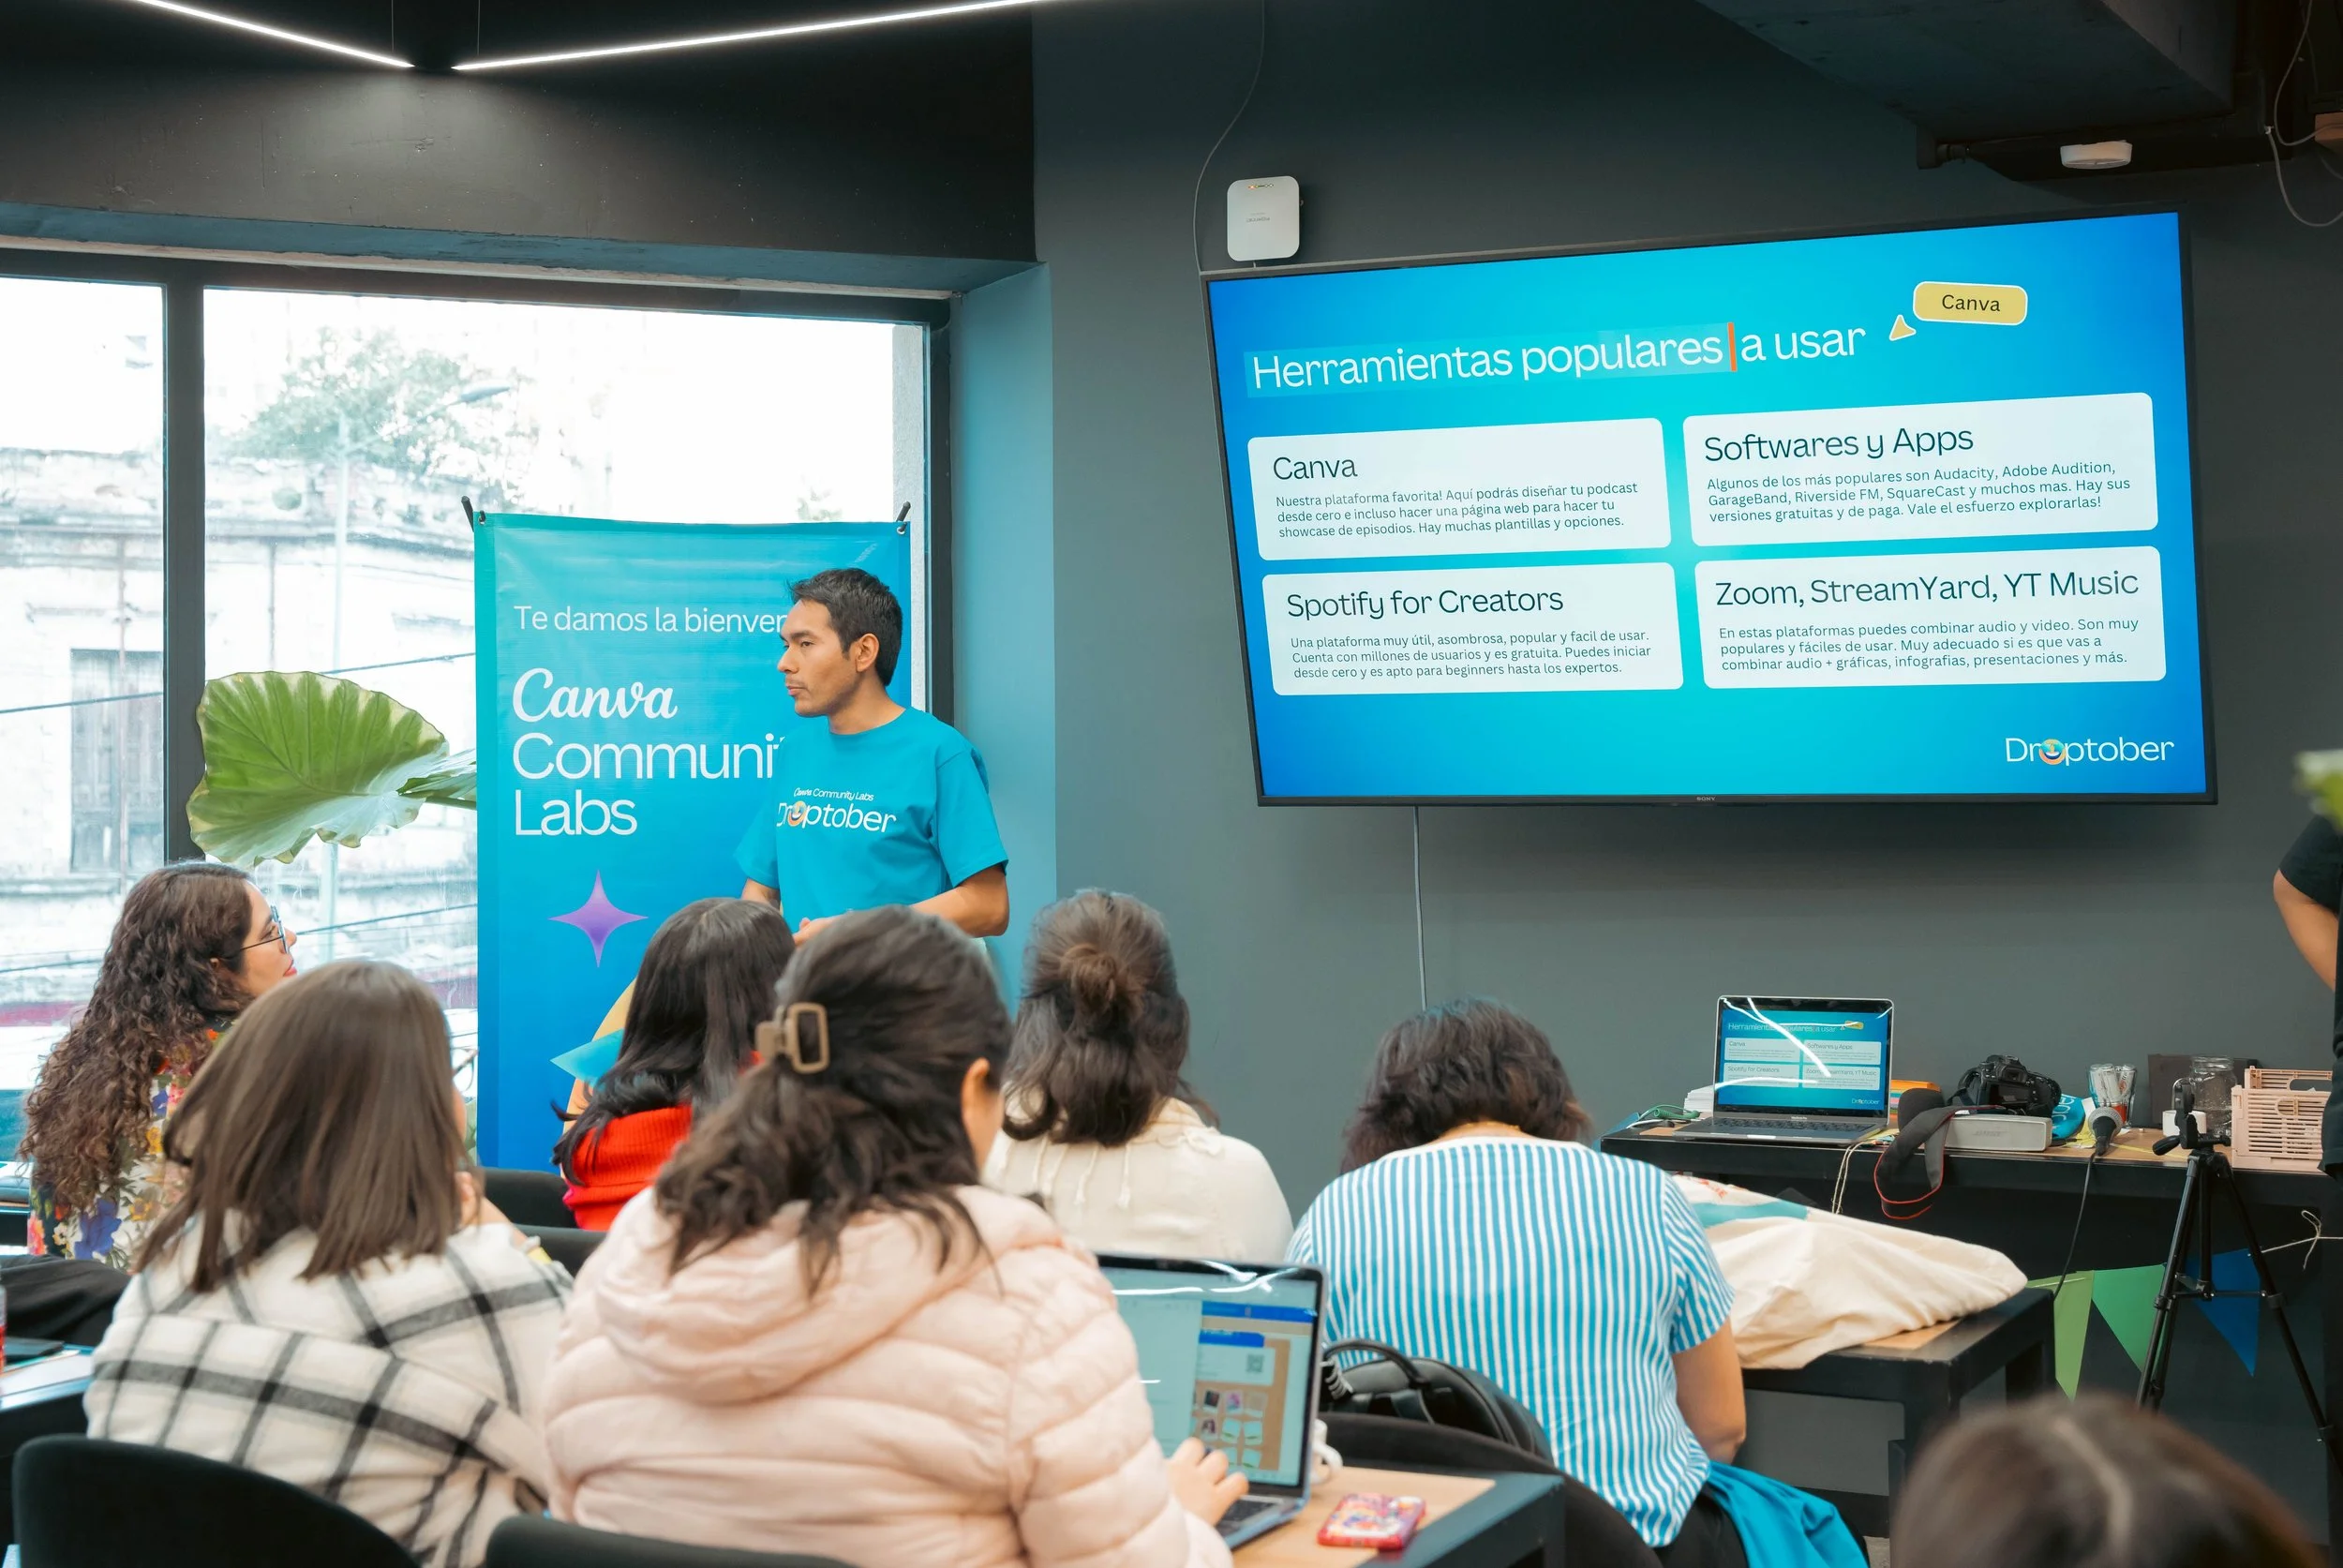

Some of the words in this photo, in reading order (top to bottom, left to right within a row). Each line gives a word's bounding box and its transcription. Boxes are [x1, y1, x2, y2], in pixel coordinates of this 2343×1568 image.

[1941, 293, 2001, 312] Canva
[1253, 346, 1514, 389] Herramientas
[1521, 333, 1724, 381] populares
[1740, 334, 1767, 362] a
[1774, 327, 1866, 360] usar
[1704, 433, 1859, 462] Softwares
[1866, 434, 1884, 459] y
[1892, 427, 1974, 457] Apps
[1273, 455, 1358, 481] Canva
[1707, 478, 1759, 493] Algunos
[1762, 475, 1779, 488] de
[1782, 475, 1801, 487] los
[1804, 472, 1831, 485] más
[1834, 471, 1903, 487] populares
[1905, 471, 1930, 482] son
[1933, 466, 1998, 482] Audacity,
[2002, 464, 2048, 478] Adobe
[2051, 461, 2115, 475] Audition,
[1276, 496, 1322, 507] Nuestra
[1324, 492, 1390, 508] plataforma
[1391, 489, 1442, 502] favorita!
[1445, 487, 1473, 502] Aquí
[1475, 486, 1519, 502] podrás
[1521, 485, 1568, 498] diseñar
[1569, 485, 1584, 496] tu
[1587, 482, 1638, 498] podcast
[1708, 491, 1791, 508] GarageBand,
[1795, 488, 1856, 502] Riverside
[1859, 487, 1883, 501] FM,
[1886, 485, 1965, 501] SquareCast
[1968, 486, 1977, 500] y
[1980, 481, 2036, 495] muchos
[2039, 482, 2071, 493] mas.
[2076, 479, 2103, 494] Hay
[2106, 479, 2130, 490] sus
[1276, 510, 1313, 523] desde
[1315, 511, 1341, 521] cero
[1344, 511, 1351, 520] e
[1353, 507, 1396, 519] incluso
[1398, 506, 1433, 518] hacer
[1435, 507, 1458, 516] una
[1460, 503, 1501, 518] página
[1503, 501, 1530, 515] web
[1532, 502, 1560, 515] para
[1563, 500, 1599, 512] hacer
[1601, 500, 1615, 510] tu
[1709, 509, 1772, 522] versiones
[1774, 506, 1833, 523] gratuitas
[1836, 508, 1844, 521] y
[1847, 505, 1865, 517] de
[1868, 505, 1903, 519] paga.
[1906, 502, 1936, 515] Vale
[1939, 501, 1953, 514] el
[1956, 500, 2015, 514] esfuerzo
[2019, 496, 2101, 513] explorarlas!
[1278, 526, 1336, 538] showcase
[1337, 524, 1353, 536] de
[1355, 522, 1415, 538] episodios.
[1418, 522, 1441, 535] Hay
[1444, 519, 1492, 532] muchas
[1494, 516, 1551, 532] plantillas
[1553, 519, 1561, 531] y
[1563, 515, 1624, 530] opciones.
[1715, 581, 1804, 608] Zoom,
[1810, 574, 1998, 604] StreamYard,
[2003, 573, 2042, 597] YT
[2050, 570, 2139, 596] Music
[1287, 590, 1384, 621] Spotify
[1389, 590, 1433, 615] for
[1438, 589, 1564, 613] Creators
[514, 605, 548, 631] Te
[554, 605, 649, 632] damos
[655, 606, 679, 633] la
[1719, 627, 1735, 639] En
[1738, 627, 1772, 638] estas
[1775, 624, 1855, 640] plataformas
[1858, 622, 1907, 638] puedes
[1910, 621, 1975, 635] combinar
[1977, 620, 2016, 633] audio
[2019, 622, 2028, 635] y
[2031, 619, 2074, 632] video.
[2077, 618, 2104, 631] Son
[2108, 619, 2139, 633] muy
[1290, 636, 1314, 648] Una
[1316, 635, 1380, 650] plataforma
[1382, 636, 1409, 649] muy
[1411, 634, 1435, 648] útil,
[1437, 633, 1507, 646] asombrosa,
[1509, 632, 1558, 646] popular
[1560, 634, 1568, 645] y
[1570, 630, 1597, 642] facil
[1599, 630, 1616, 642] de
[1618, 632, 1649, 641] usar.
[1720, 642, 1785, 657] populares
[1787, 644, 1796, 656] y
[1798, 641, 1842, 653] fáciles
[1844, 640, 1861, 652] de
[1864, 642, 1897, 652] usar.
[1900, 639, 1930, 653] Muy
[1933, 636, 2000, 650] adecuado
[2003, 636, 2014, 649] si
[2018, 639, 2033, 649] es
[2036, 637, 2063, 650] que
[2066, 637, 2090, 647] vas
[2093, 636, 2102, 647] a
[1291, 651, 1335, 664] Cuenta
[1336, 653, 1358, 663] con
[1360, 650, 1410, 662] millones
[1412, 650, 1428, 661] de
[1430, 649, 1482, 661] usuarios
[1484, 650, 1491, 663] y
[1494, 650, 1508, 660] es
[1511, 647, 1562, 662] gratuita.
[1564, 646, 1610, 658] Puedes
[1613, 645, 1651, 657] iniciar
[1721, 658, 1783, 671] combinar
[1785, 657, 1823, 669] audio
[1836, 656, 1891, 671] gráficas,
[1894, 654, 1970, 670] infografias,
[1973, 652, 2080, 668] presentaciones
[2082, 654, 2091, 666] y
[2095, 650, 2127, 664] más.
[1293, 666, 1329, 679] desde
[1331, 668, 1358, 678] cero
[1359, 668, 1367, 680] y
[1369, 667, 1383, 677] es
[1385, 666, 1413, 679] apto
[1415, 666, 1443, 679] para
[1444, 664, 1505, 679] beginners
[1507, 663, 1542, 675] hasta
[1544, 663, 1562, 674] los
[1564, 663, 1622, 676] expertos.
[513, 667, 679, 723] Canva
[513, 732, 785, 780] Communi
[2005, 736, 2175, 767] Droptober
[813, 788, 856, 800] Community
[856, 792, 874, 801] Labs
[515, 788, 638, 836] Labs
